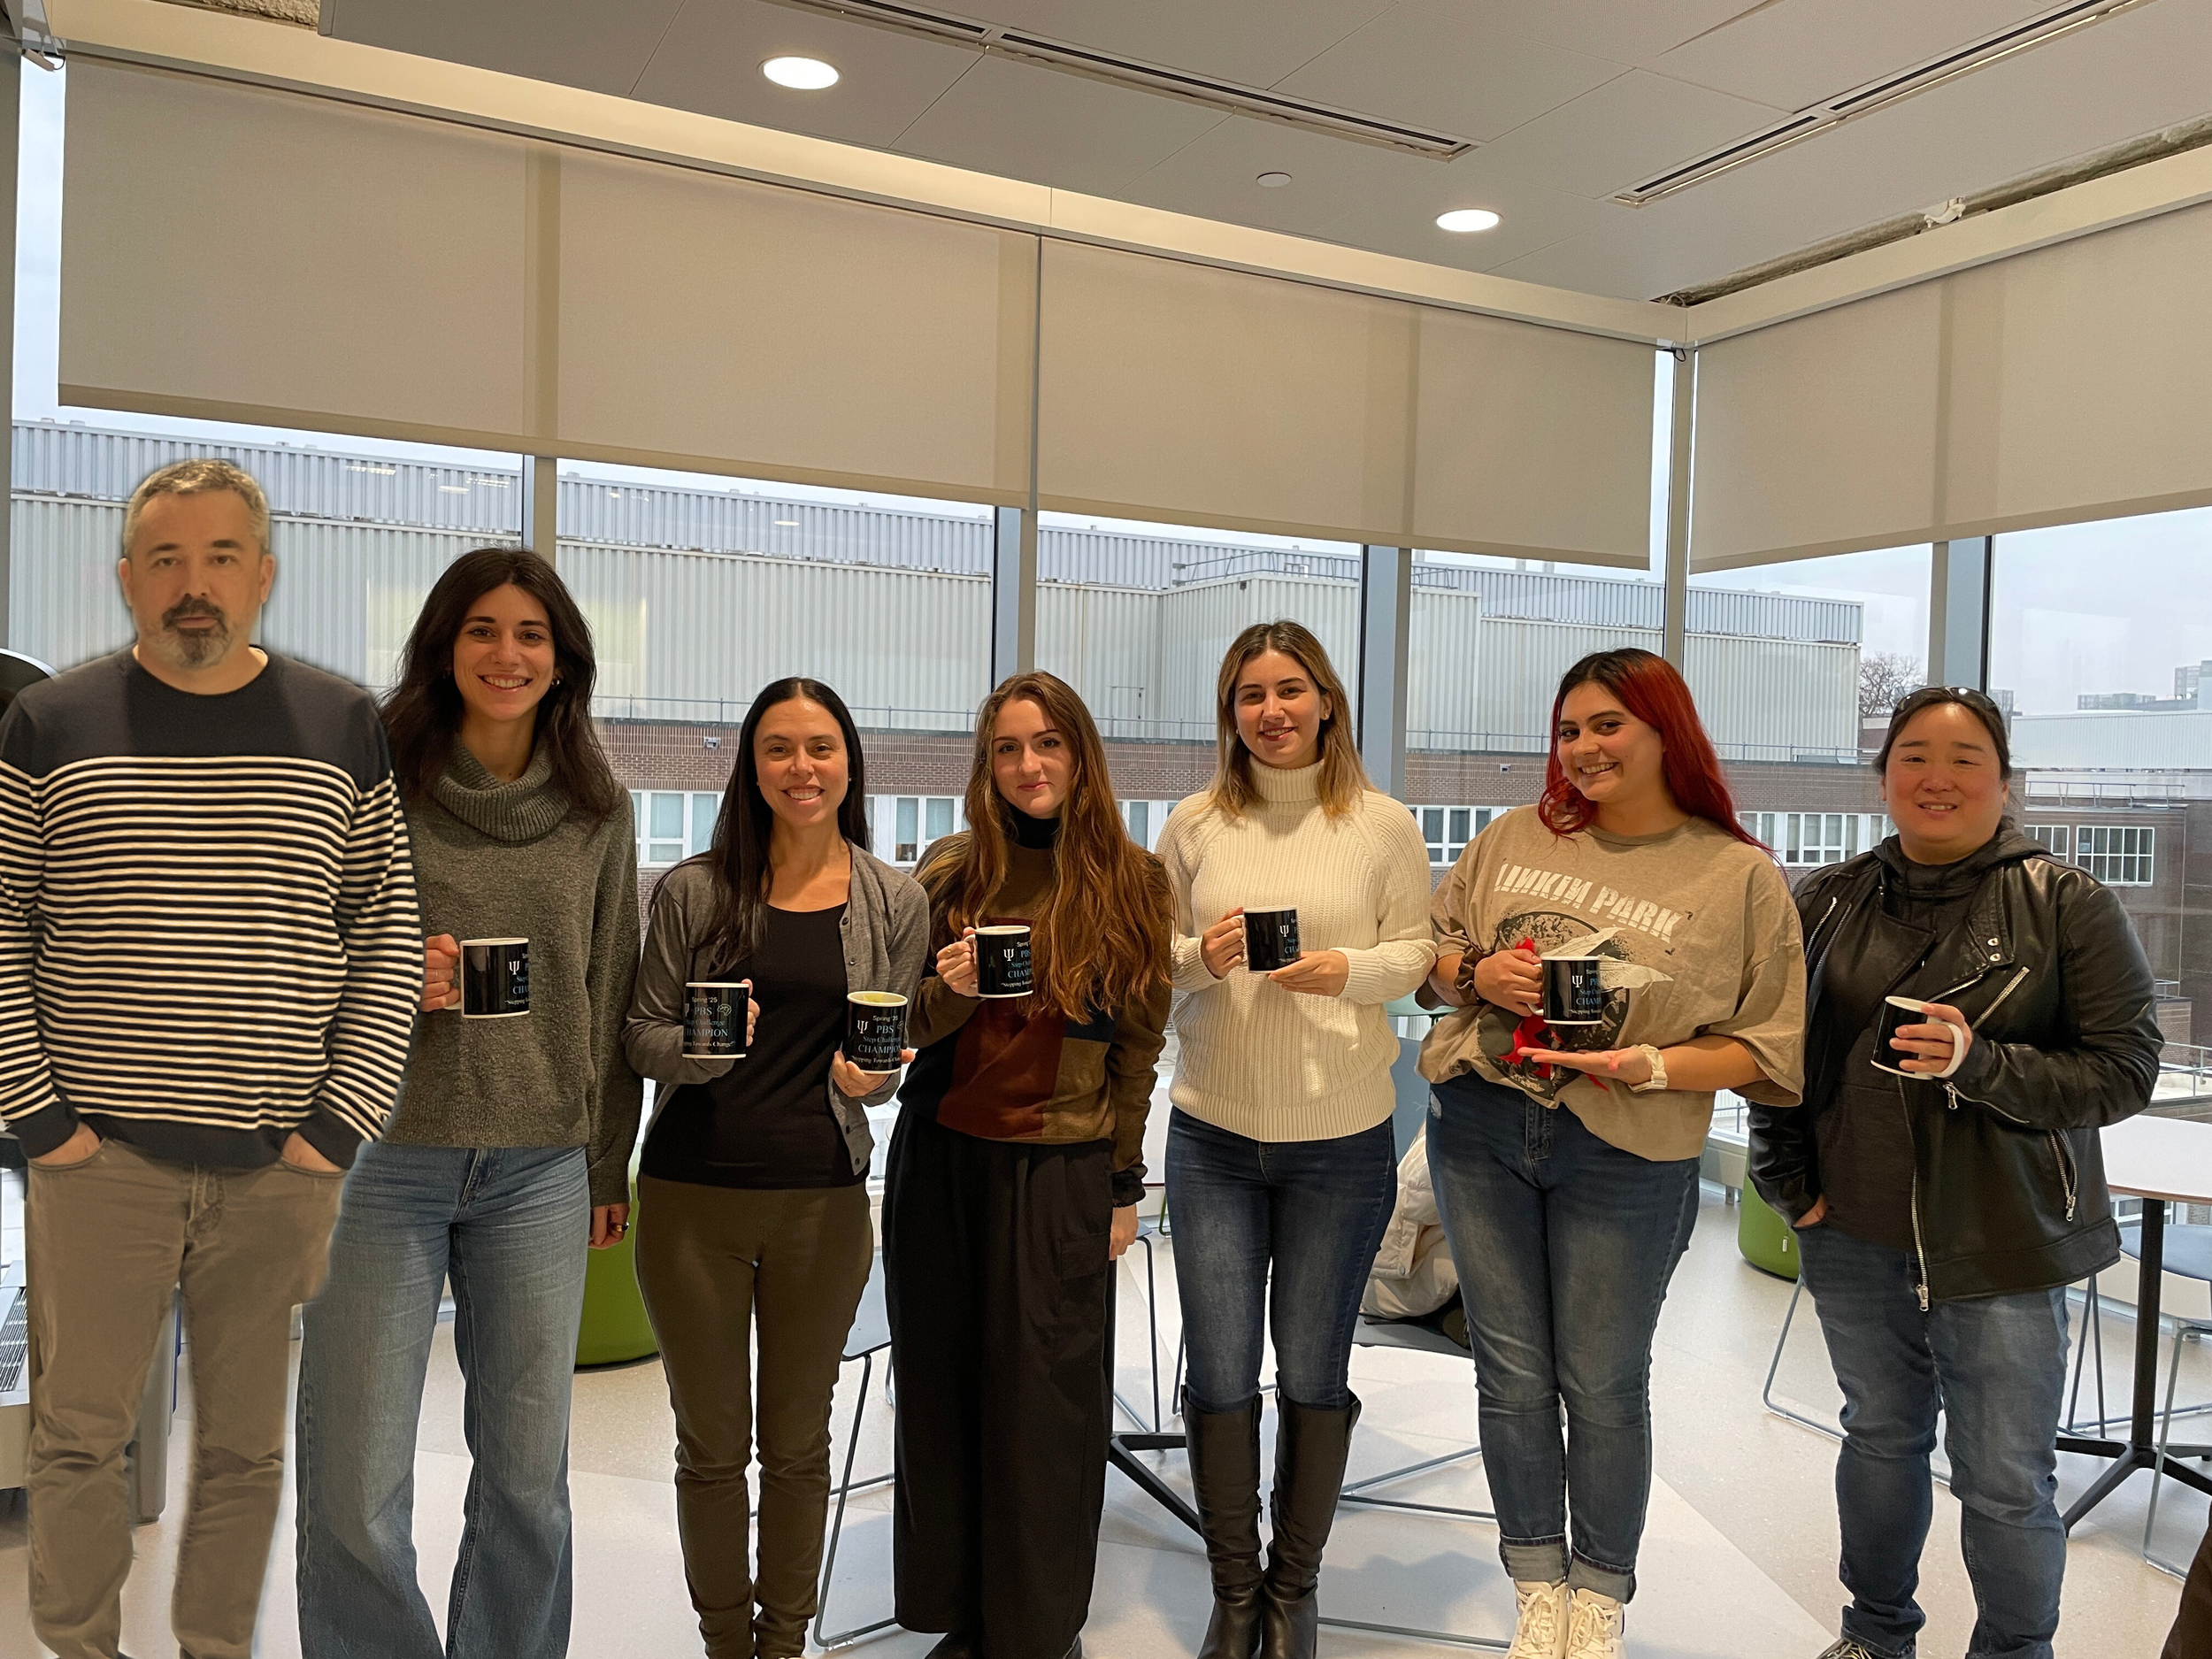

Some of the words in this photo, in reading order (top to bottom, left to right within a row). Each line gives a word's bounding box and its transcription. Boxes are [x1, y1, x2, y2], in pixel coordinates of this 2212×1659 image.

[1494, 863, 1594, 910] LINKIN
[1588, 886, 1683, 944] PARK
[694, 1006, 713, 1016] PBS
[872, 1014, 891, 1023] Spring
[876, 1025, 895, 1034] PBS
[862, 1035, 877, 1044] Step
